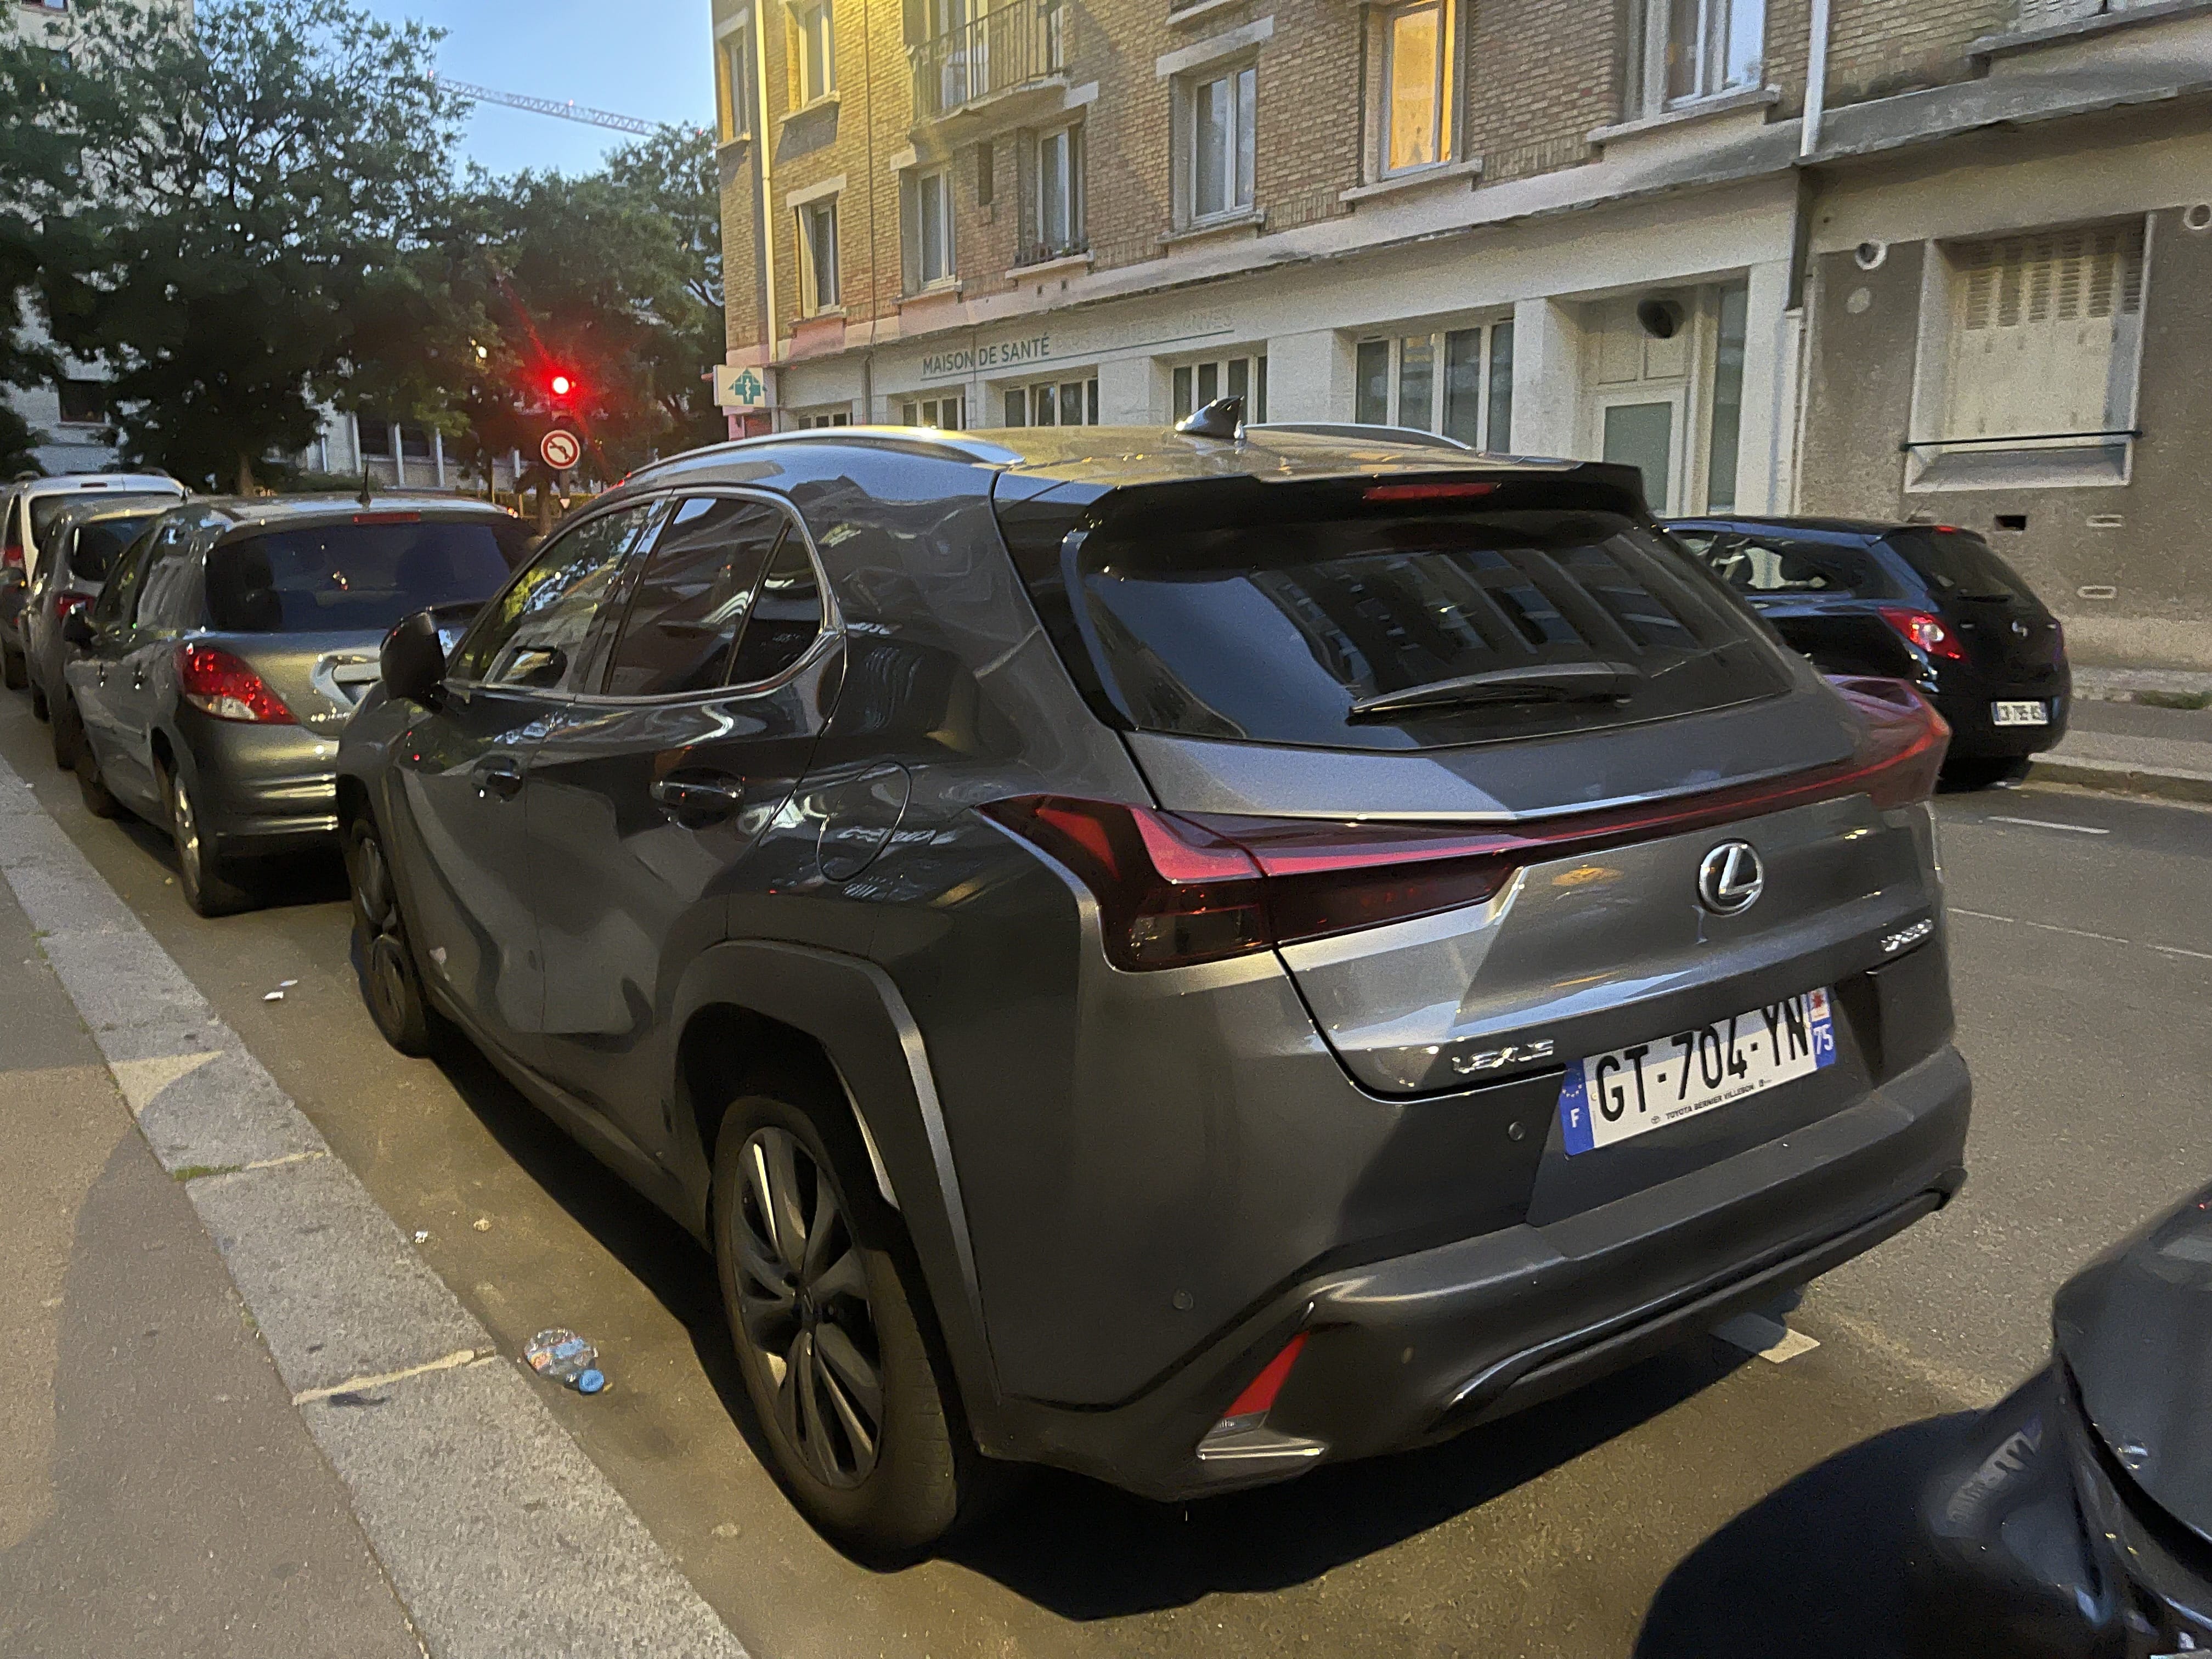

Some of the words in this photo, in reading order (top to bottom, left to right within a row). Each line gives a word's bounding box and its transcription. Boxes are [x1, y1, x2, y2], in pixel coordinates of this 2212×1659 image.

[923, 350, 974, 375] MAISON
[979, 346, 996, 365] DE
[1002, 332, 1050, 362] SANTÉ
[1452, 1040, 1554, 1074] LEXUS
[1570, 1107, 1580, 1128] F
[1596, 994, 1809, 1122] GT-704-YN
[1813, 1024, 1834, 1054] 75
[1666, 1106, 1692, 1120] TOYOTA
[1694, 1094, 1722, 1110] BERNIER
